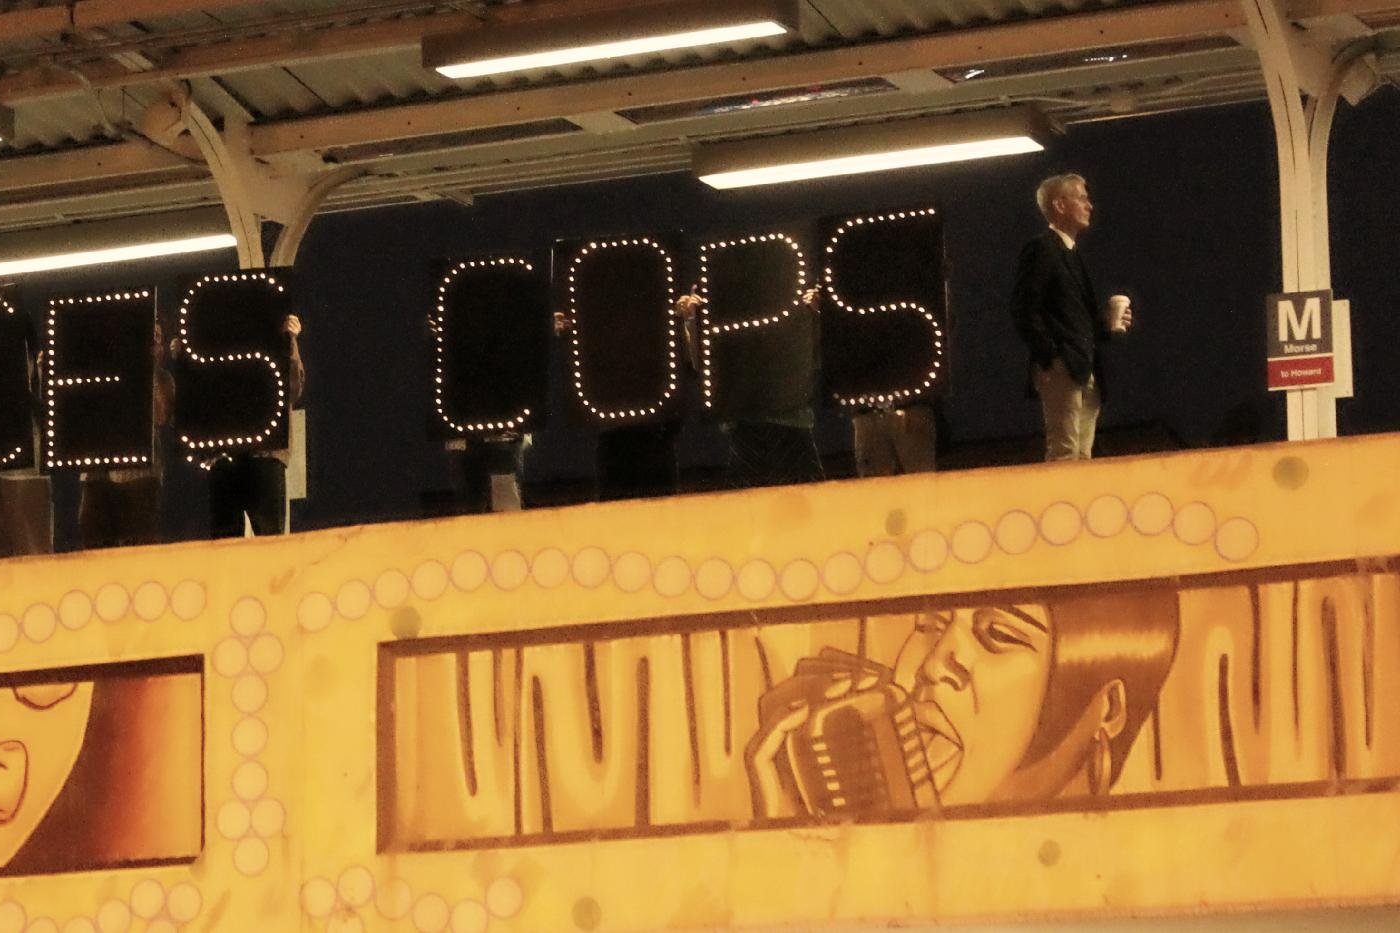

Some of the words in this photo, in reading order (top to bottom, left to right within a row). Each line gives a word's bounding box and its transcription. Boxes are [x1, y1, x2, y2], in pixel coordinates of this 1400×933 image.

[434, 207, 939, 433] COPS
[1277, 297, 1322, 342] M
[1284, 344, 1318, 354] Morse
[1280, 370, 1289, 378] to
[1291, 368, 1322, 377] Howard
